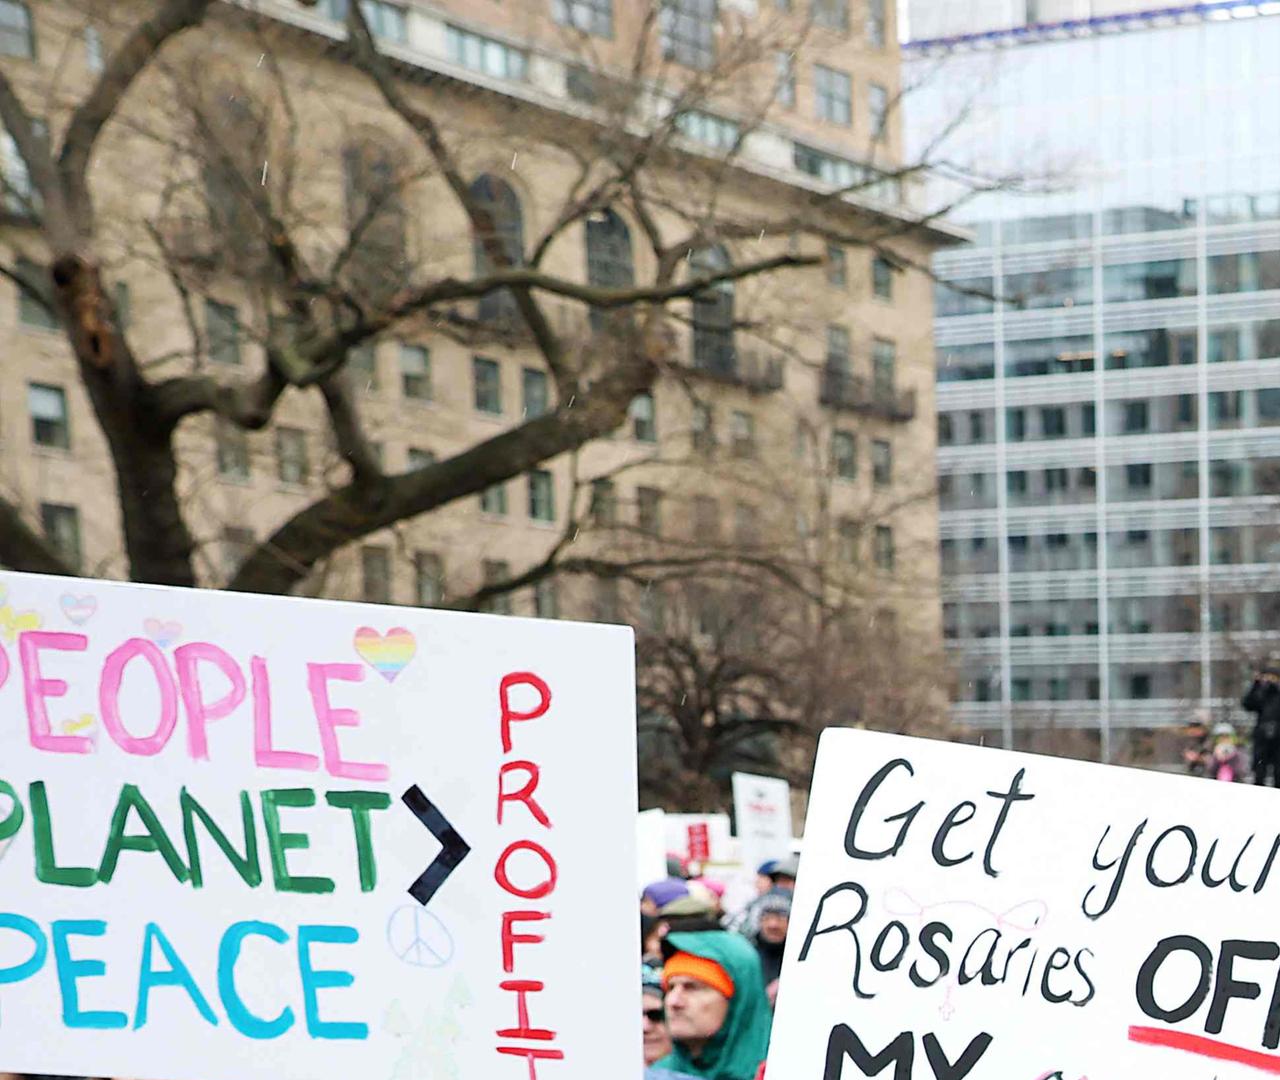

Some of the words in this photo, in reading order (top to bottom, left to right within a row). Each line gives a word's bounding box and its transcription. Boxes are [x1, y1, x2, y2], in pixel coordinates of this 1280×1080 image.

[0, 630, 391, 781] EOPLE
[843, 756, 1036, 877] Get
[0, 912, 369, 1041] PEACE
[798, 881, 1096, 1007] Rosaries
